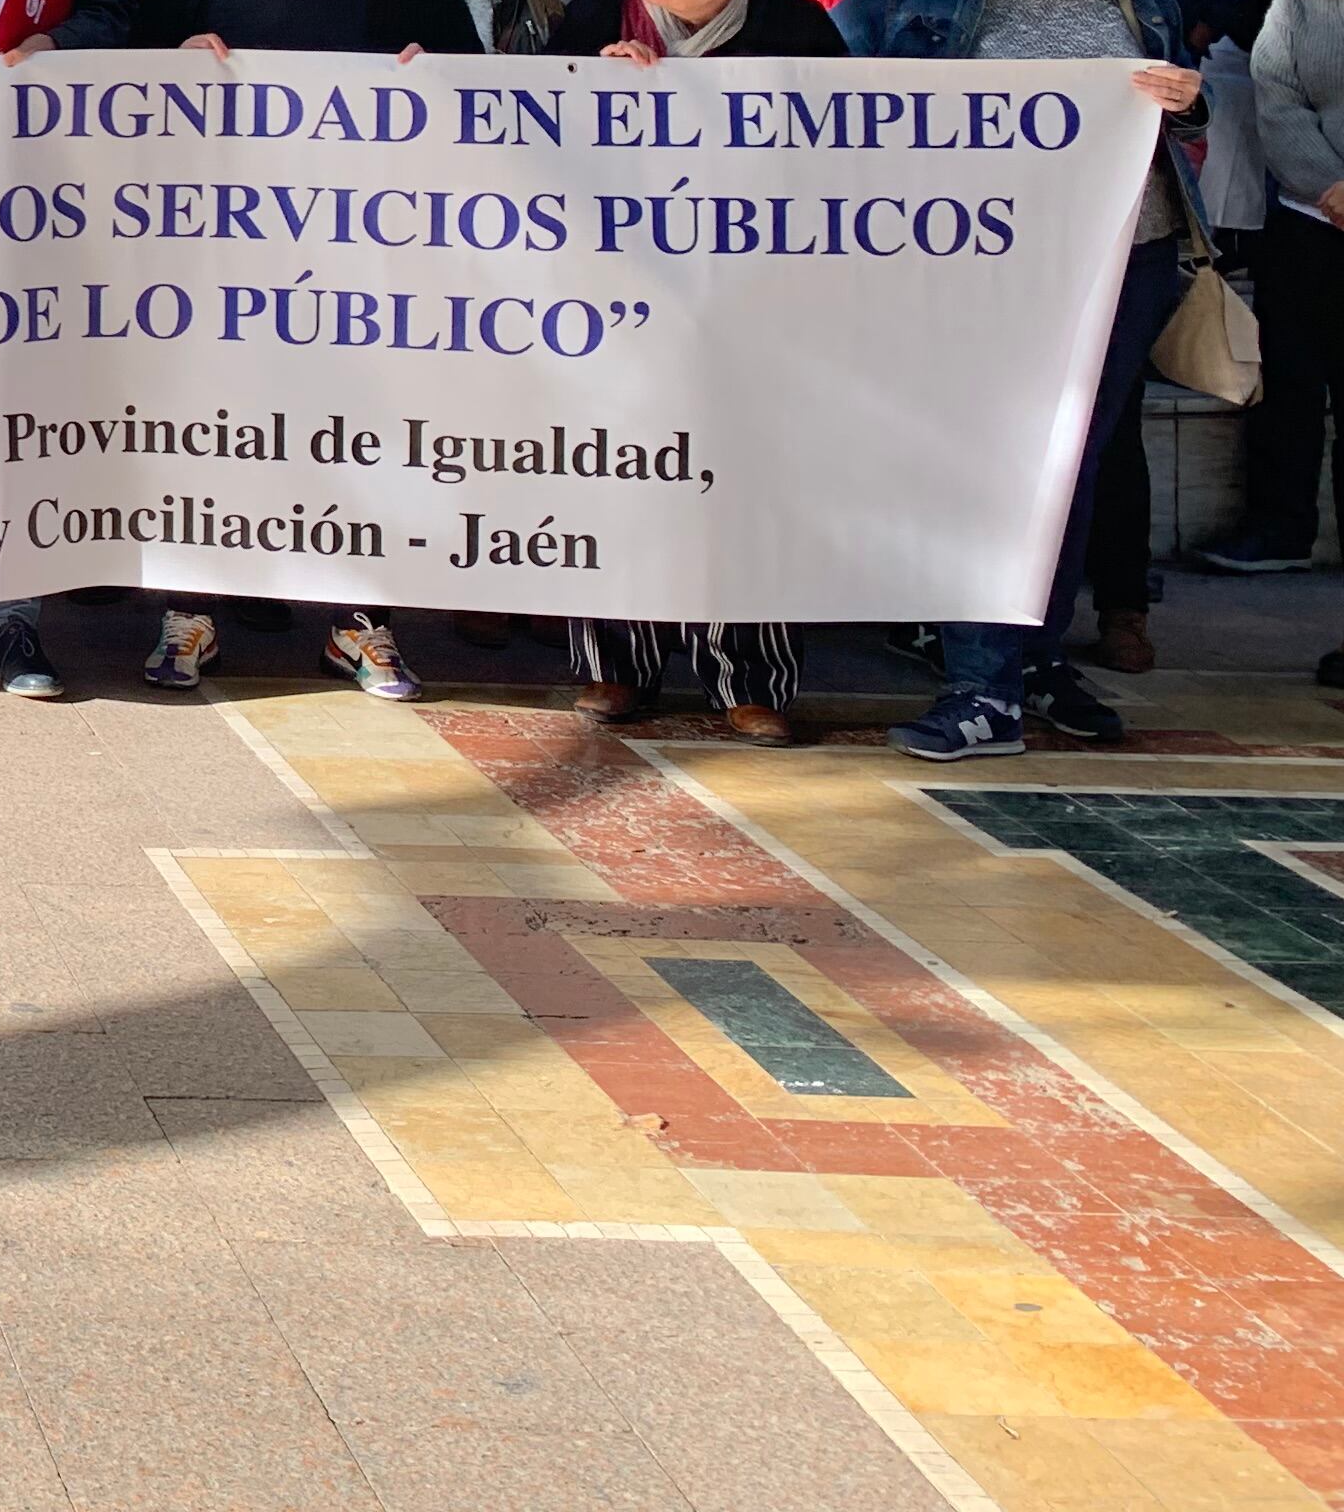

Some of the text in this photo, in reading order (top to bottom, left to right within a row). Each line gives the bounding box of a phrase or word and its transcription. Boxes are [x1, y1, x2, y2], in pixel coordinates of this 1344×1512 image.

[11, 84, 427, 142] DIGNIDAD
[458, 89, 566, 144] EN
[591, 91, 700, 147] EL
[726, 92, 1080, 149] EMPLEO
[115, 184, 567, 250] SERVICIOS
[598, 177, 1012, 255] PÚBLICOS
[81, 286, 192, 341] LO
[3, 405, 288, 463] Provincial
[310, 415, 381, 465] de
[402, 419, 713, 494] Igualdad,
[28, 495, 385, 557] Conciliación
[409, 538, 426, 547] -
[450, 513, 600, 569] Jaén
